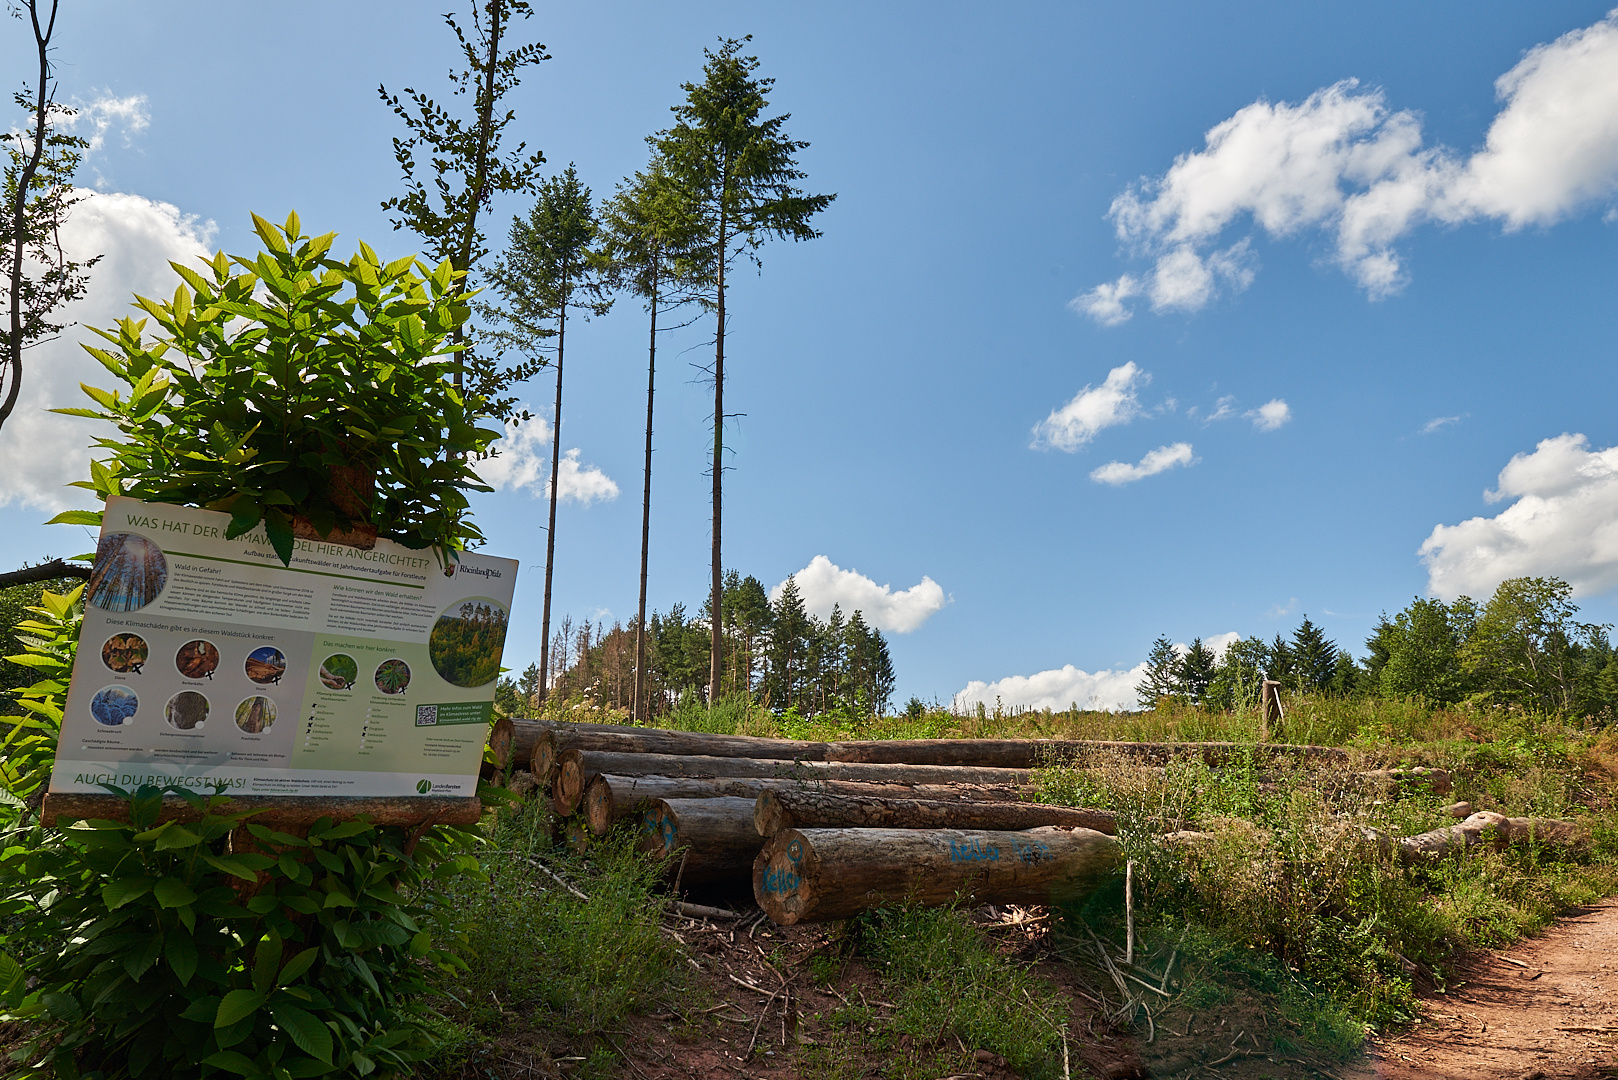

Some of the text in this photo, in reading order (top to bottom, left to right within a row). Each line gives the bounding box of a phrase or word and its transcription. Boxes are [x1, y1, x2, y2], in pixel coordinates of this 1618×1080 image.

[125, 514, 158, 529] WAS
[162, 519, 190, 533] HAT
[192, 524, 218, 538] DER
[316, 543, 343, 556] HIER
[345, 547, 430, 569] ANGERICHTET?
[198, 566, 221, 574] Gefahr!
[243, 549, 265, 558] Aufbau
[339, 563, 391, 575] Jahrhundertaufgabe
[400, 572, 426, 580] Forstleute
[104, 617, 276, 642] Diese Klimaschäden gibt es in diesem Waldstück konkret:
[73, 773, 117, 784] AUCH
[120, 774, 142, 785] DU
[146, 775, 209, 786] BEWEGST
[948, 838, 1000, 863] Keller
[762, 866, 802, 894] Keller
